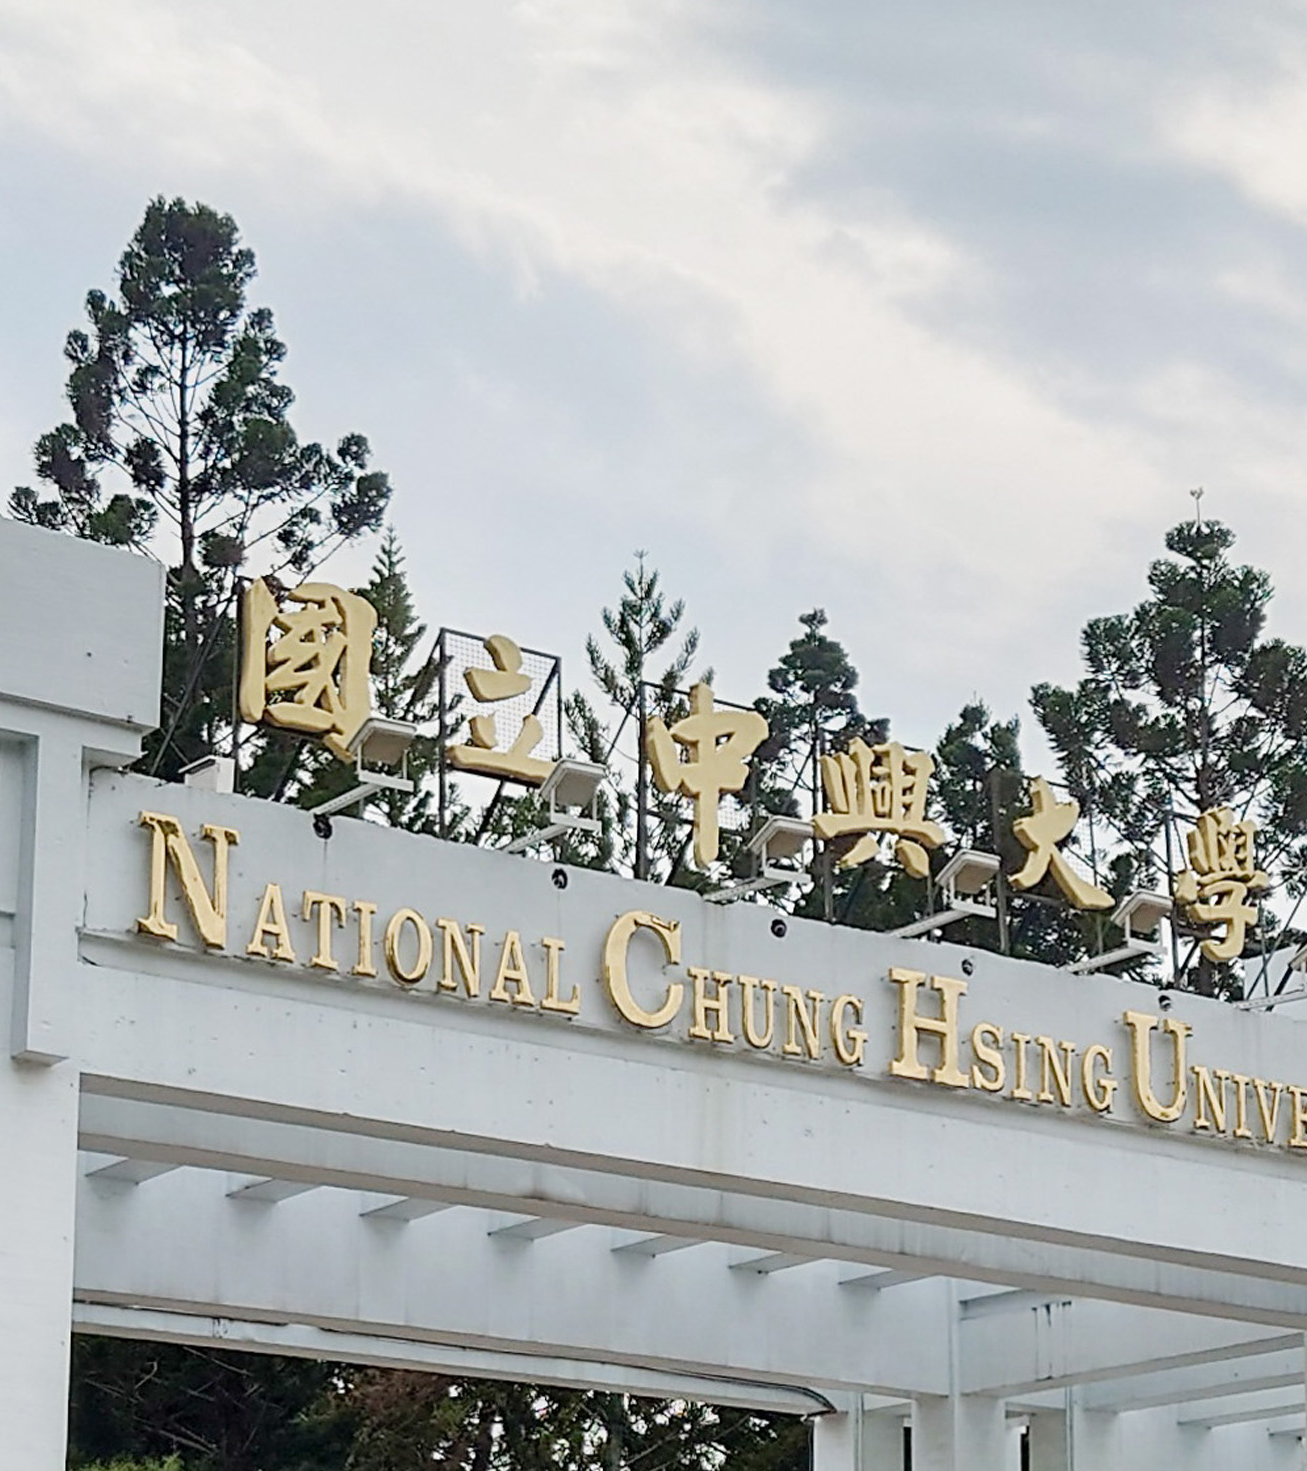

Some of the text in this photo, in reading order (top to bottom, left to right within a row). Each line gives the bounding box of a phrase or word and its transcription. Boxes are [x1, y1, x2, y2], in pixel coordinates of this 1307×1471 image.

[238, 576, 1268, 961] 國立中興大學
[136, 811, 581, 1017] NATIONAL
[604, 910, 868, 1067] CHUNG
[889, 967, 1117, 1114] HSING
